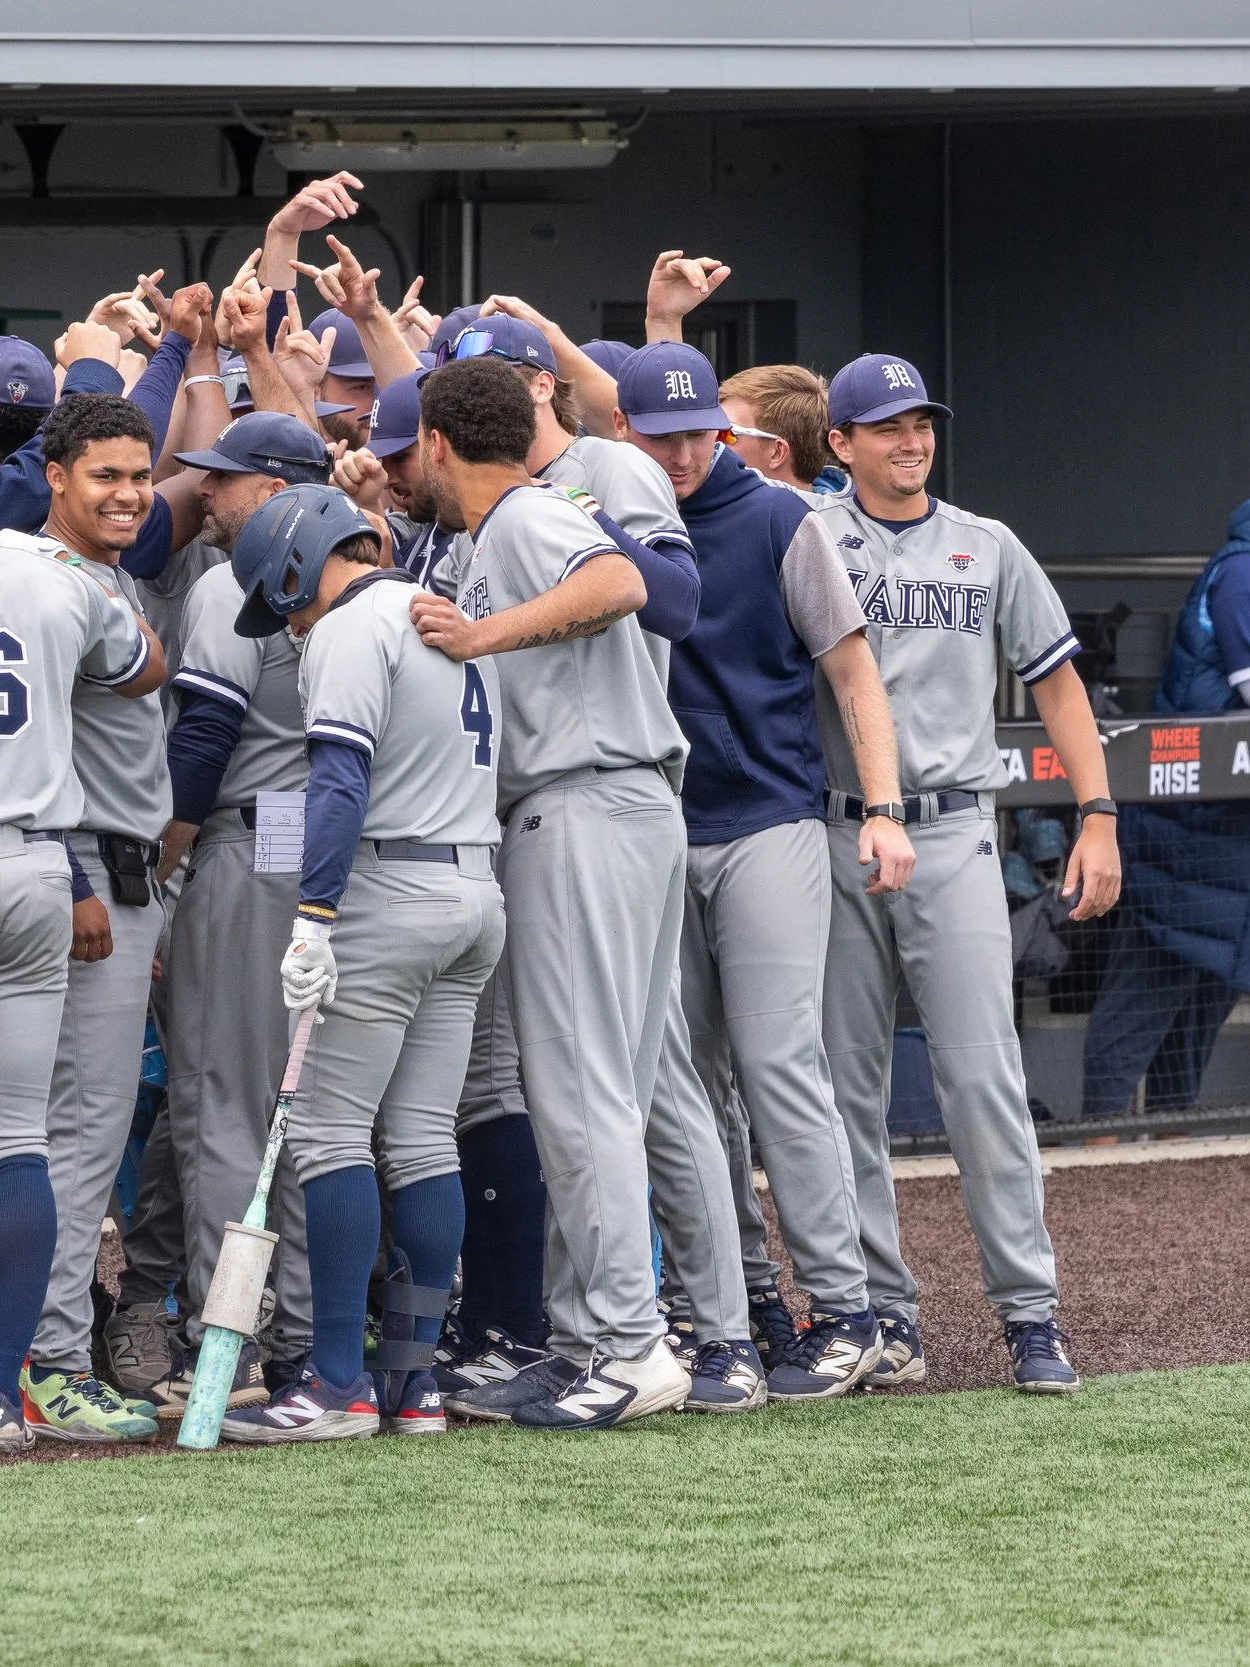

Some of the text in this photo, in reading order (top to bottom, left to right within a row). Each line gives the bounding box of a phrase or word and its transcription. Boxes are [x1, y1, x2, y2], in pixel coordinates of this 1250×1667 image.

[458, 660, 494, 772] 4
[1151, 727, 1200, 748] WHERE
[1150, 748, 1200, 763] CHAMPIONS
[1150, 761, 1200, 796] RISE
